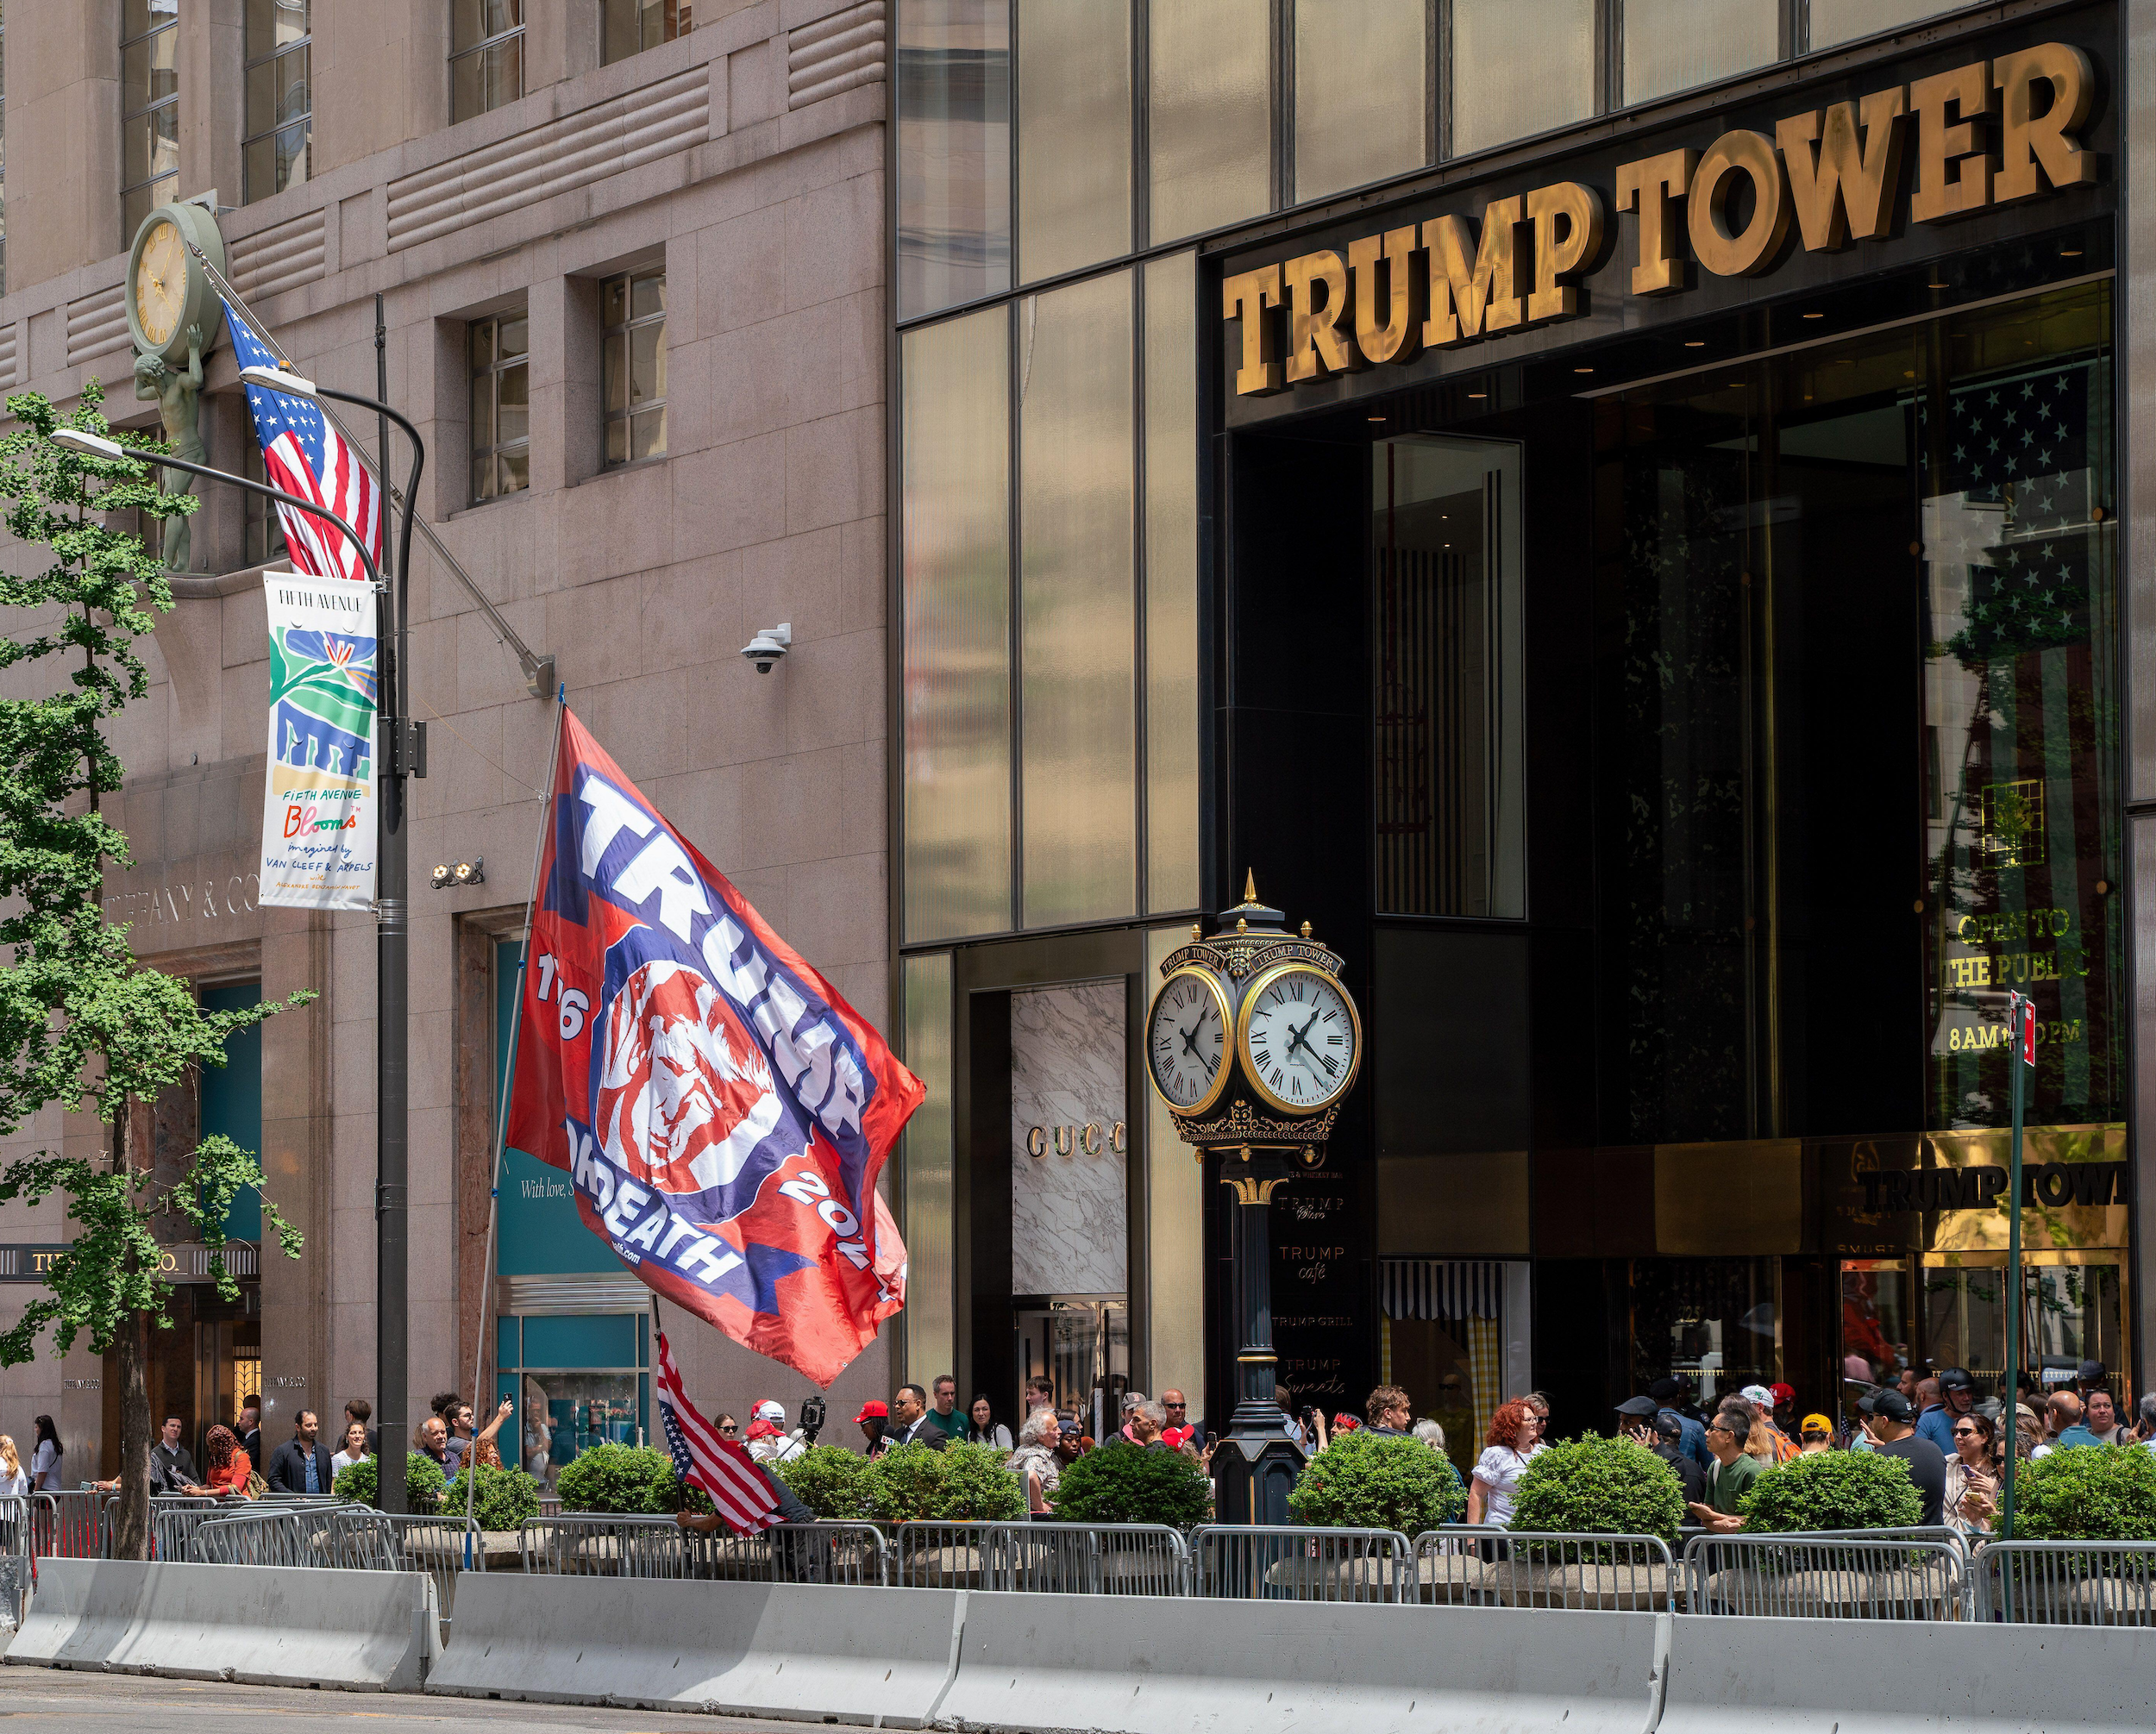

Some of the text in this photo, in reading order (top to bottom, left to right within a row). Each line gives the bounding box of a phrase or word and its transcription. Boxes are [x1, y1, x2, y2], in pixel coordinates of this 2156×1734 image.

[1223, 41, 2097, 398] TRUMP TOWER
[279, 589, 363, 613] FIFTH AVENUE
[320, 790, 361, 800] AVENUE
[284, 804, 356, 838] Blooms
[288, 842, 352, 859] imagined by
[266, 857, 373, 873] VAN CLEEF & ARPELS
[203, 880, 217, 917] &
[1958, 908, 2070, 945] OPEN TO
[579, 773, 866, 1141] TRUMP
[1163, 948, 1219, 972] TRUMP TOWER
[1255, 945, 1334, 968] TRUMP TOWER
[1943, 948, 2090, 988] THE PUBLIC
[2048, 1018, 2082, 1044] PM
[521, 1178, 545, 1199] With
[547, 1177, 566, 1199] love,
[1858, 1165, 2009, 1211] TRUMP
[1278, 1197, 1344, 1211] TRUMP
[594, 1156, 745, 1285] DEATH
[1279, 1247, 1344, 1260] TRUMP
[1298, 1261, 1326, 1284] café
[1271, 1317, 1353, 1326] TRUMP GRILL
[1285, 1359, 1341, 1370] TRUMP
[1284, 1374, 1345, 1393] Sweets
